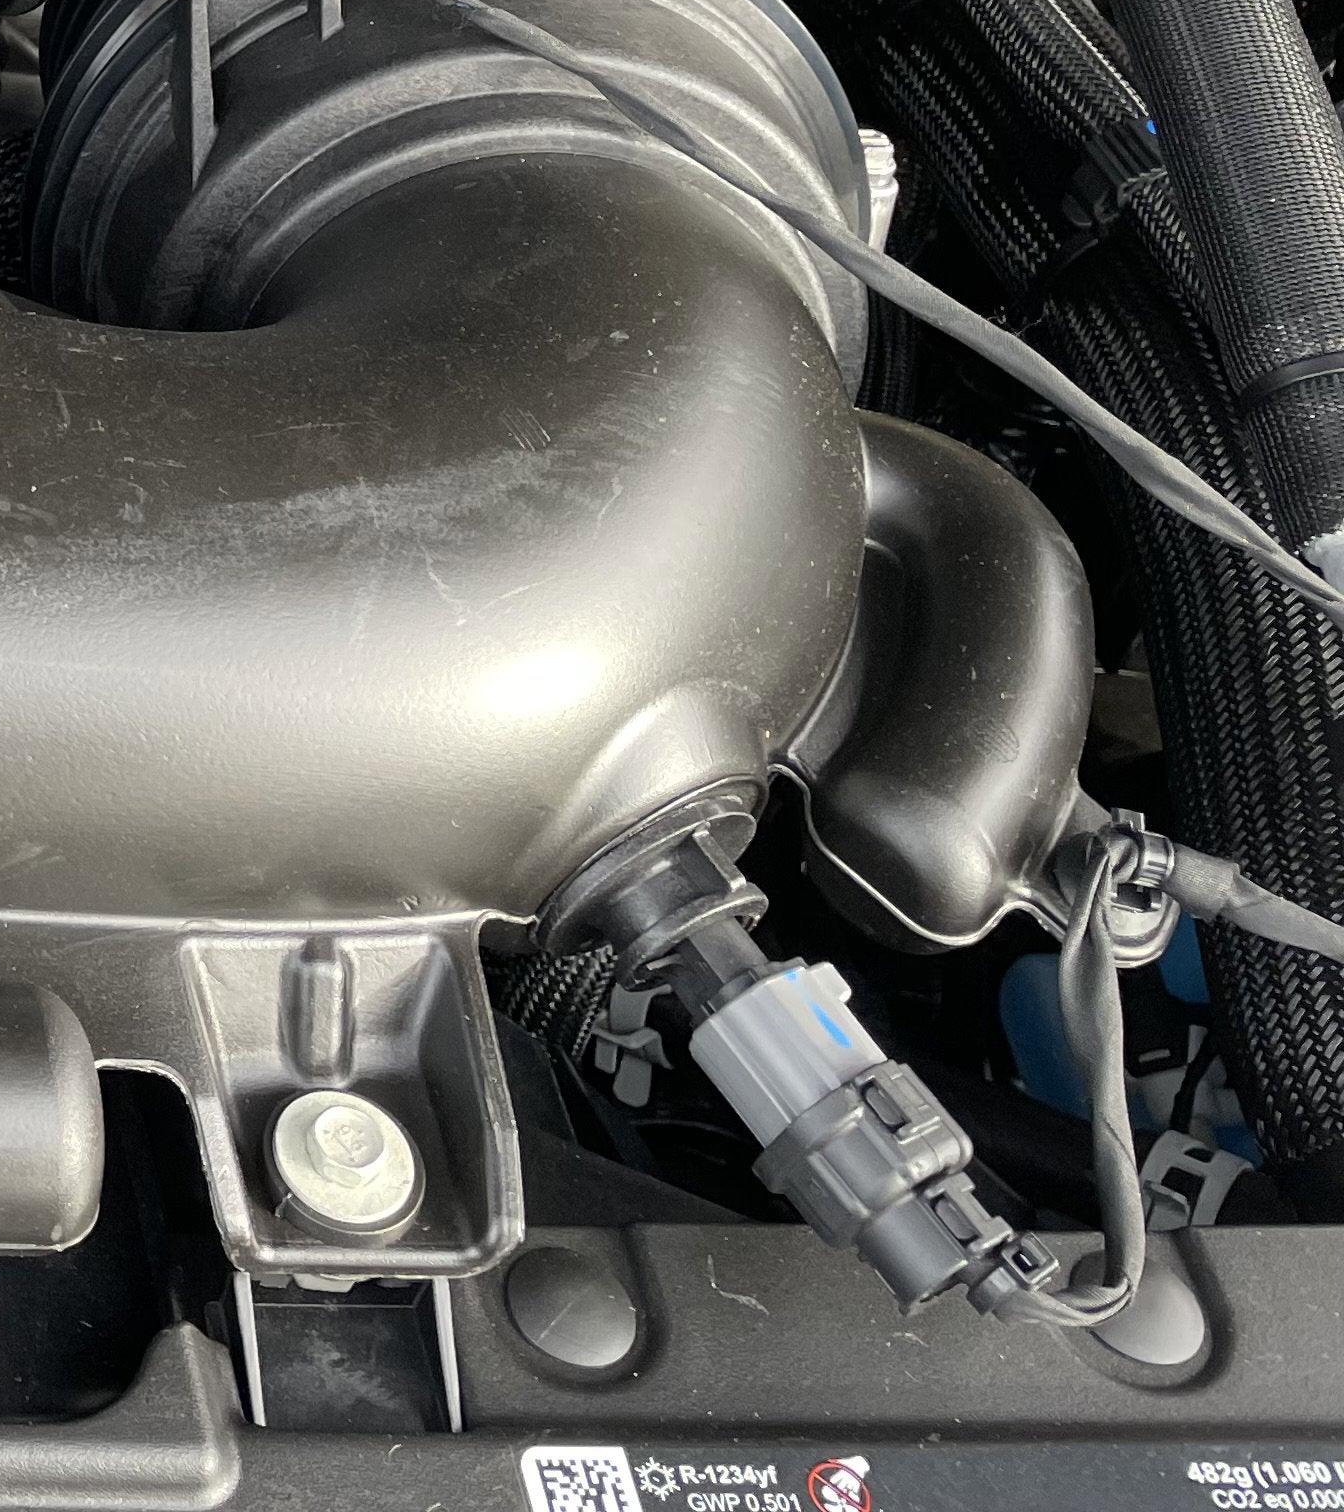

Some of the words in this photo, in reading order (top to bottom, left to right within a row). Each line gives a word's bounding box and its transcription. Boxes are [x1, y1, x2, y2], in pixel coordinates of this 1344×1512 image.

[678, 1464, 778, 1489] R-1234yf
[1187, 1460, 1253, 1489] 482g
[687, 1492, 741, 1512] GWP
[744, 1492, 802, 1512] 0.501
[1211, 1489, 1262, 1509] CO2
